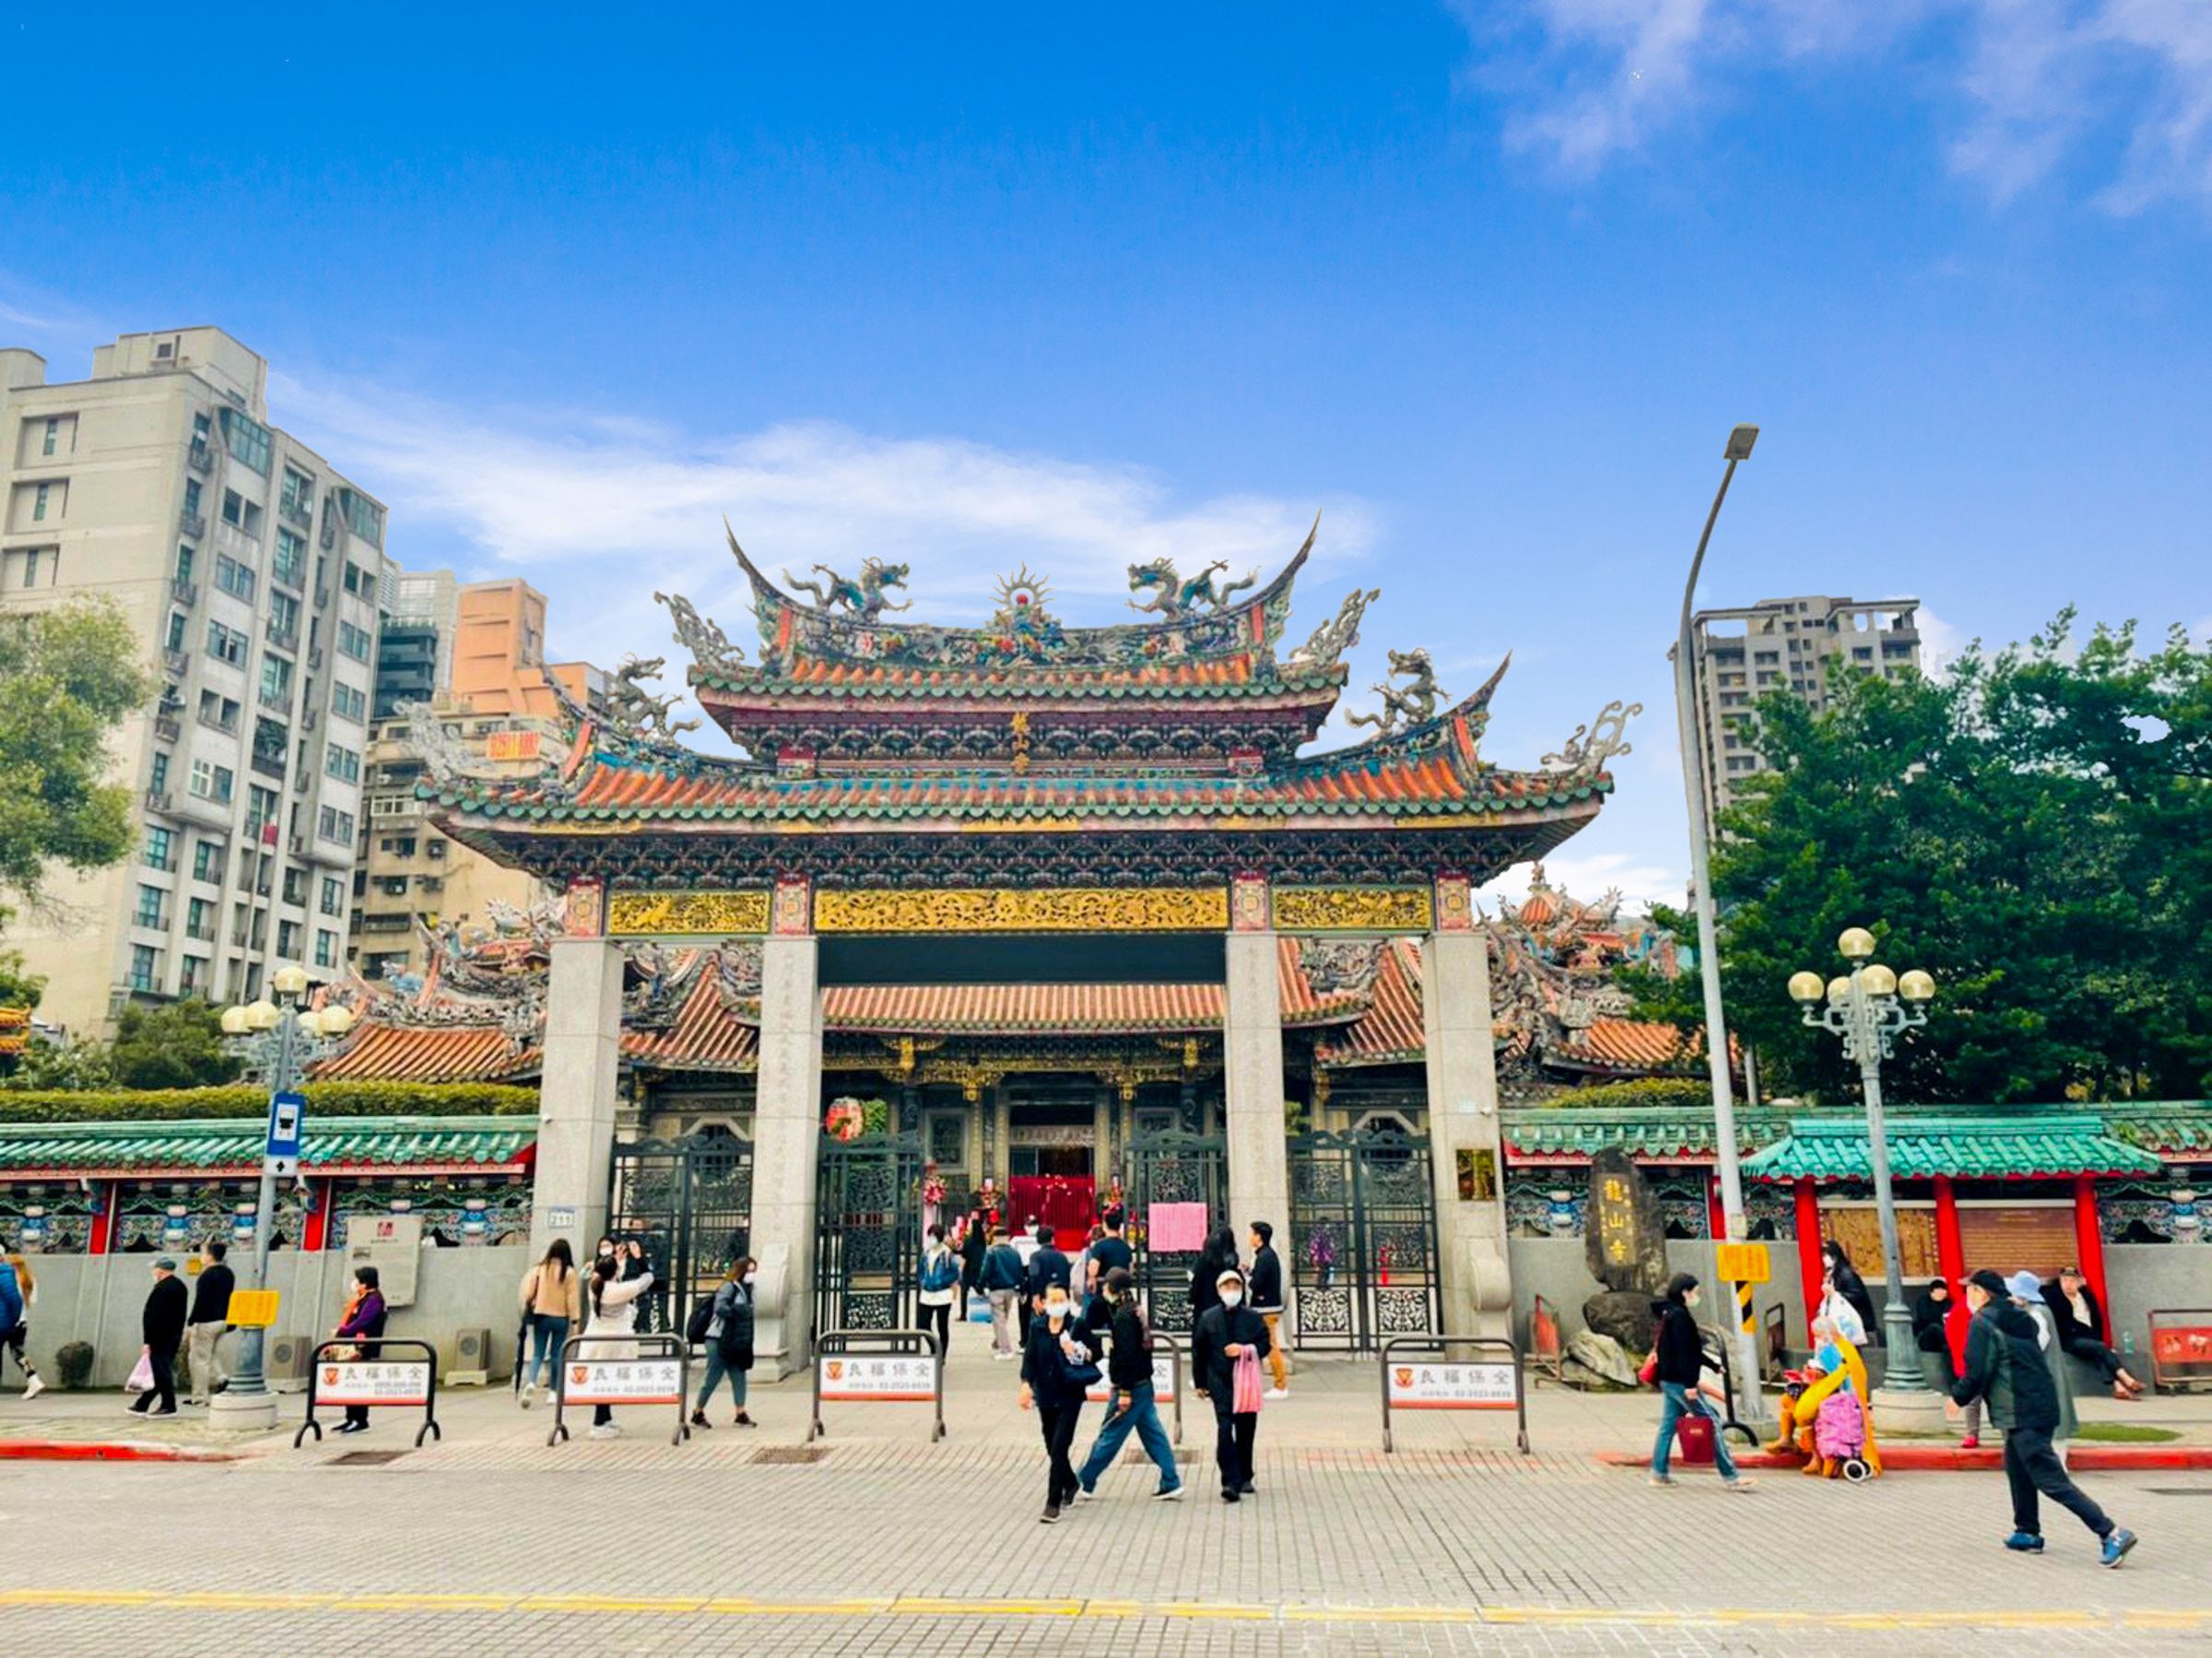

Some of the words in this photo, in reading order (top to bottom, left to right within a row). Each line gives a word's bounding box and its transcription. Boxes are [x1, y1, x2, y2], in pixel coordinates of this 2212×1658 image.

[1604, 1179, 1627, 1261] 龍山寺
[594, 1367, 675, 1381] 良福保全
[849, 1362, 930, 1377] 良福保全
[1420, 1370, 1509, 1384] 良福保全
